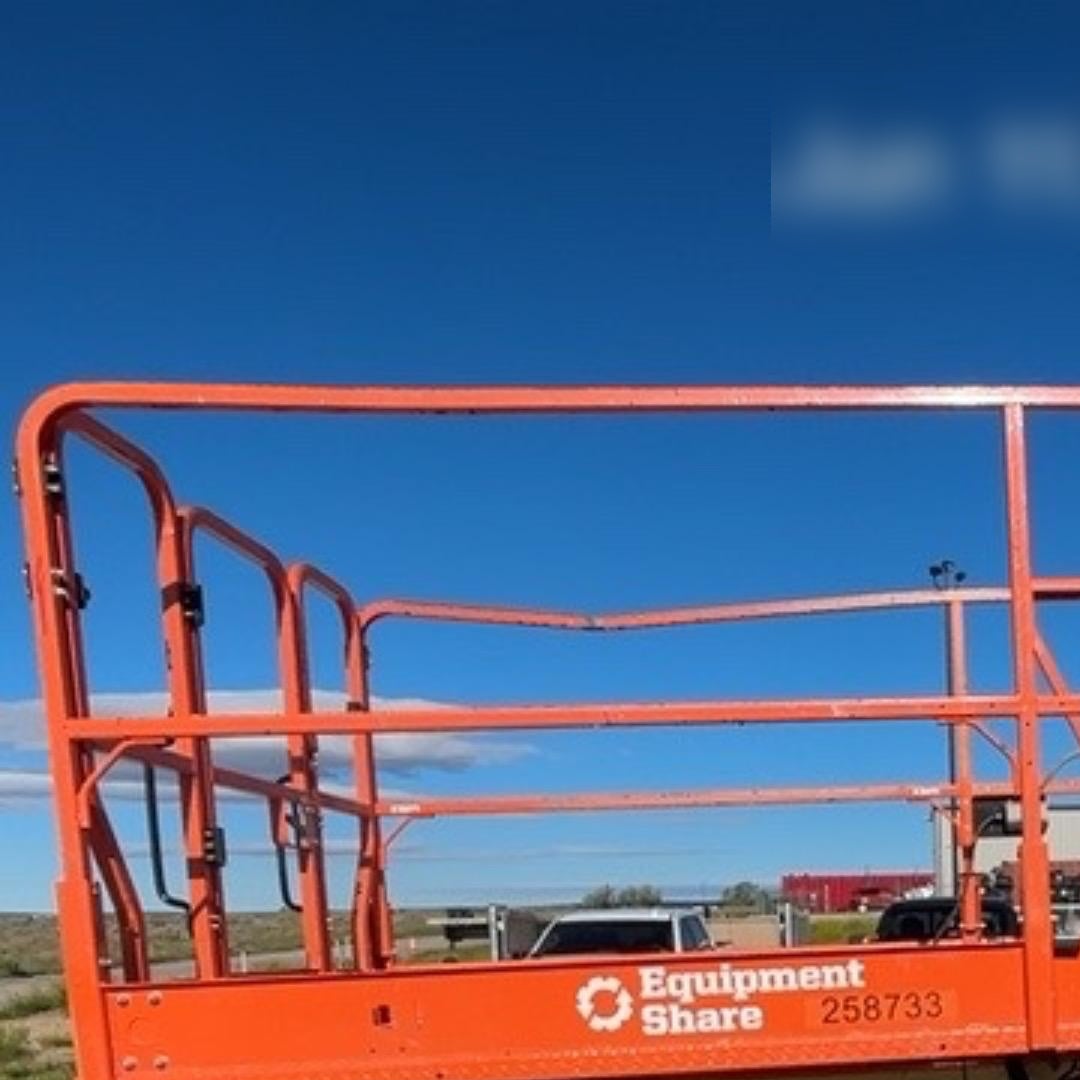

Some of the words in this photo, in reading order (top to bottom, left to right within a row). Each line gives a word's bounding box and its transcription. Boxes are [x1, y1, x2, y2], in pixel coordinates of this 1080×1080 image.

[640, 960, 865, 1002] Equipment
[641, 1003, 763, 1037] Share
[821, 991, 944, 1025] 258733
